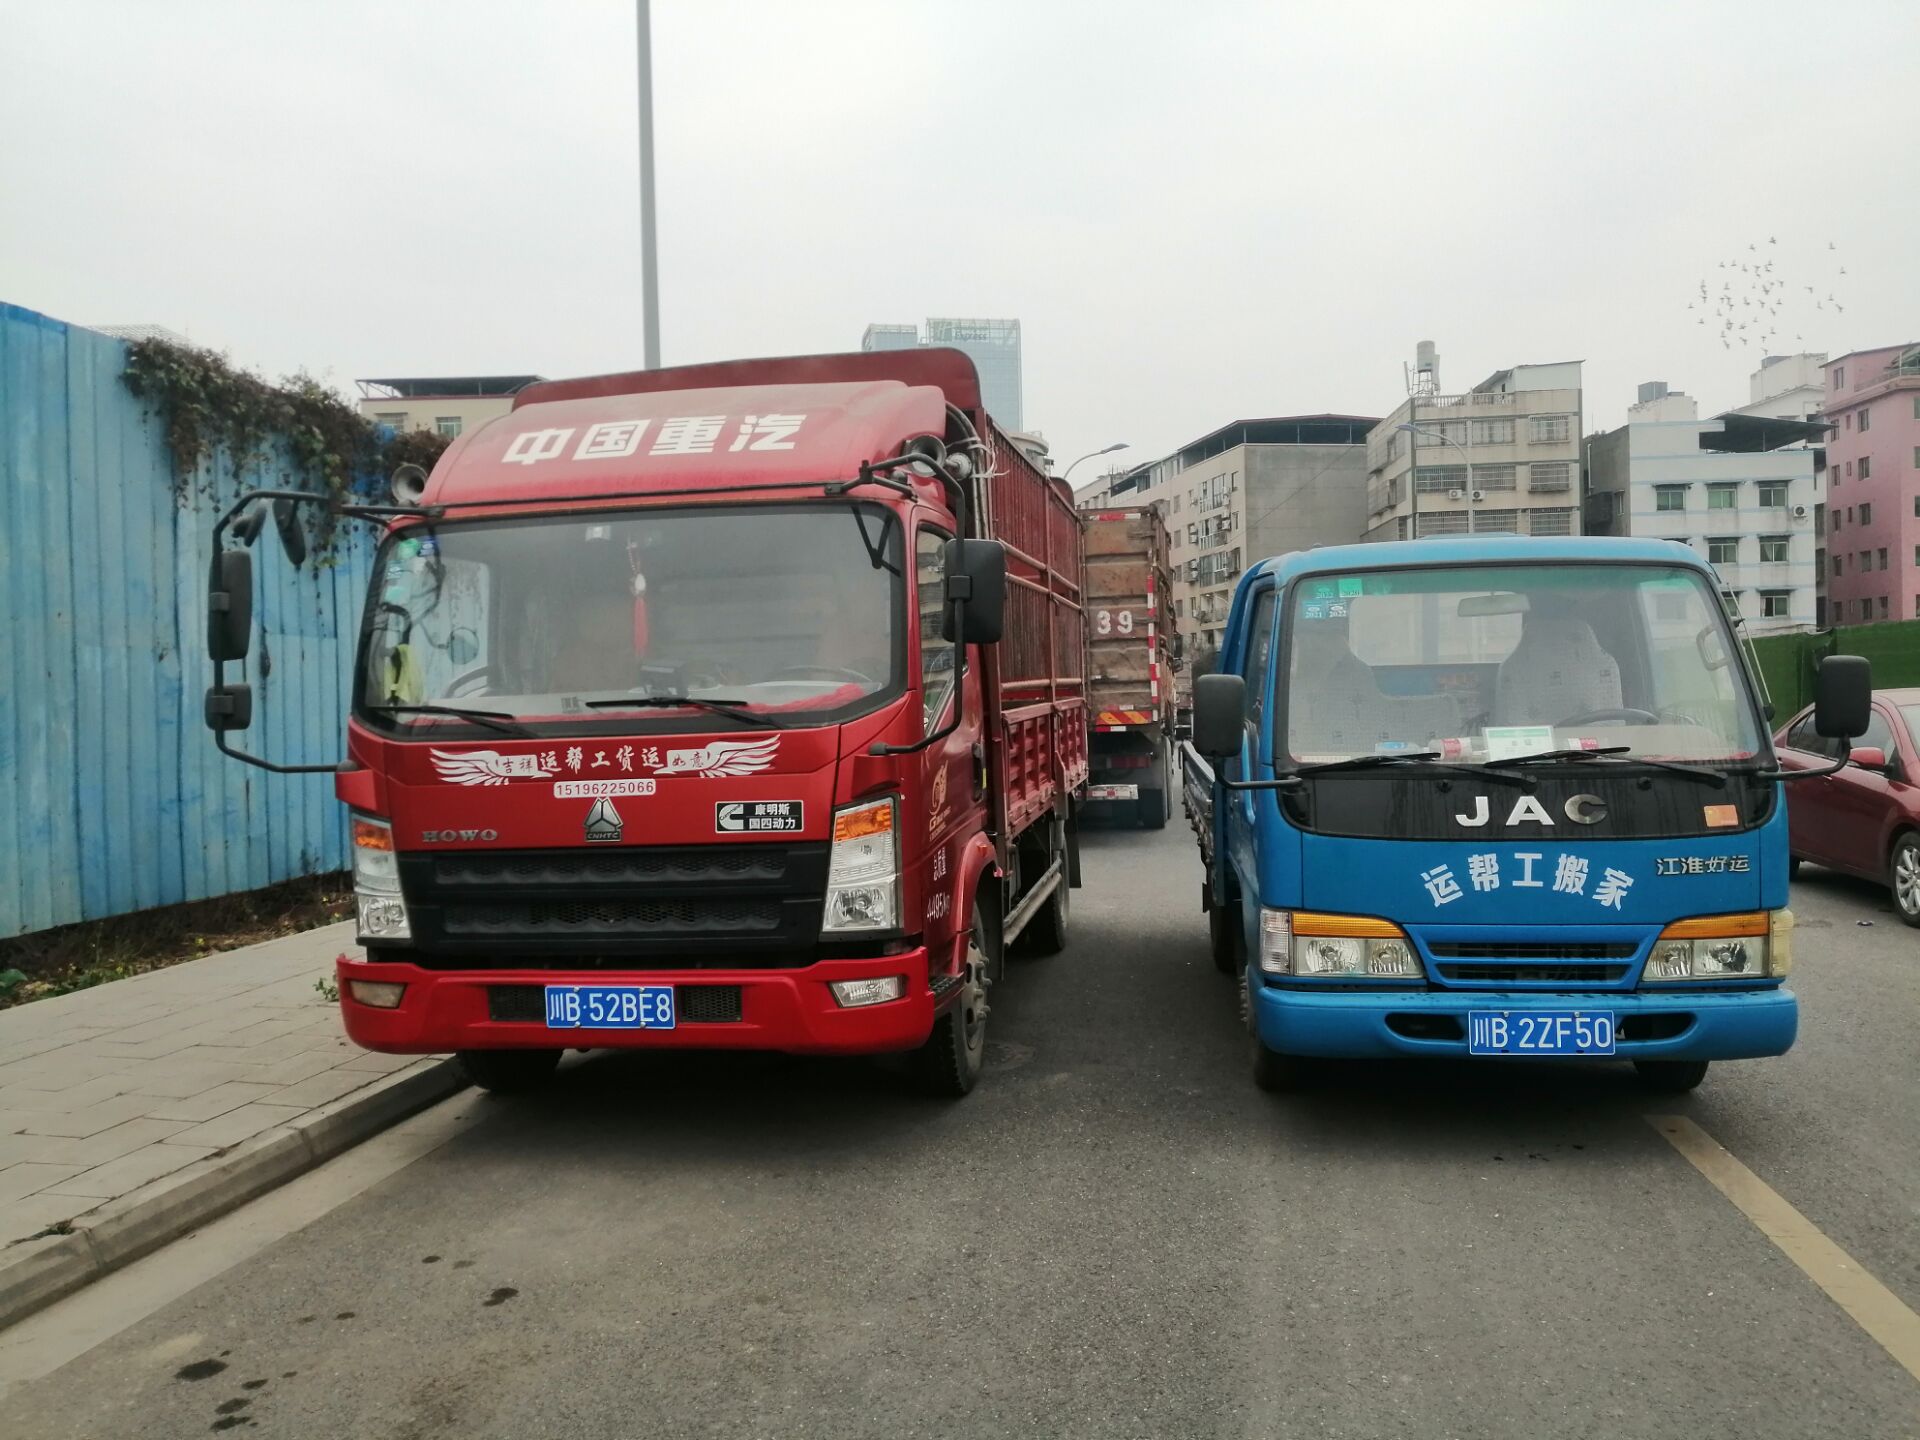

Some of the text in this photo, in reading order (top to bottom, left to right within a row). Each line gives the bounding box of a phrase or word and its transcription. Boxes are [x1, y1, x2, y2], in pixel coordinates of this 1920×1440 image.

[501, 413, 807, 465] 中国重汽
[1097, 610, 1132, 634] 39
[502, 745, 705, 774] 吉祥 运帮工货运 如意
[556, 782, 654, 795] 15196225066
[755, 803, 791, 815] 康明斯
[1455, 794, 1608, 827] JAC
[749, 817, 796, 829] 国四动力
[422, 829, 498, 842] HOWO
[587, 832, 618, 840] CNHTC
[1656, 855, 1750, 875] 江淮好运
[1420, 853, 1634, 911] 运帮工搬家
[550, 992, 671, 1022] 川B·52BE8
[1473, 1017, 1611, 1048] 川B·2ZF50
